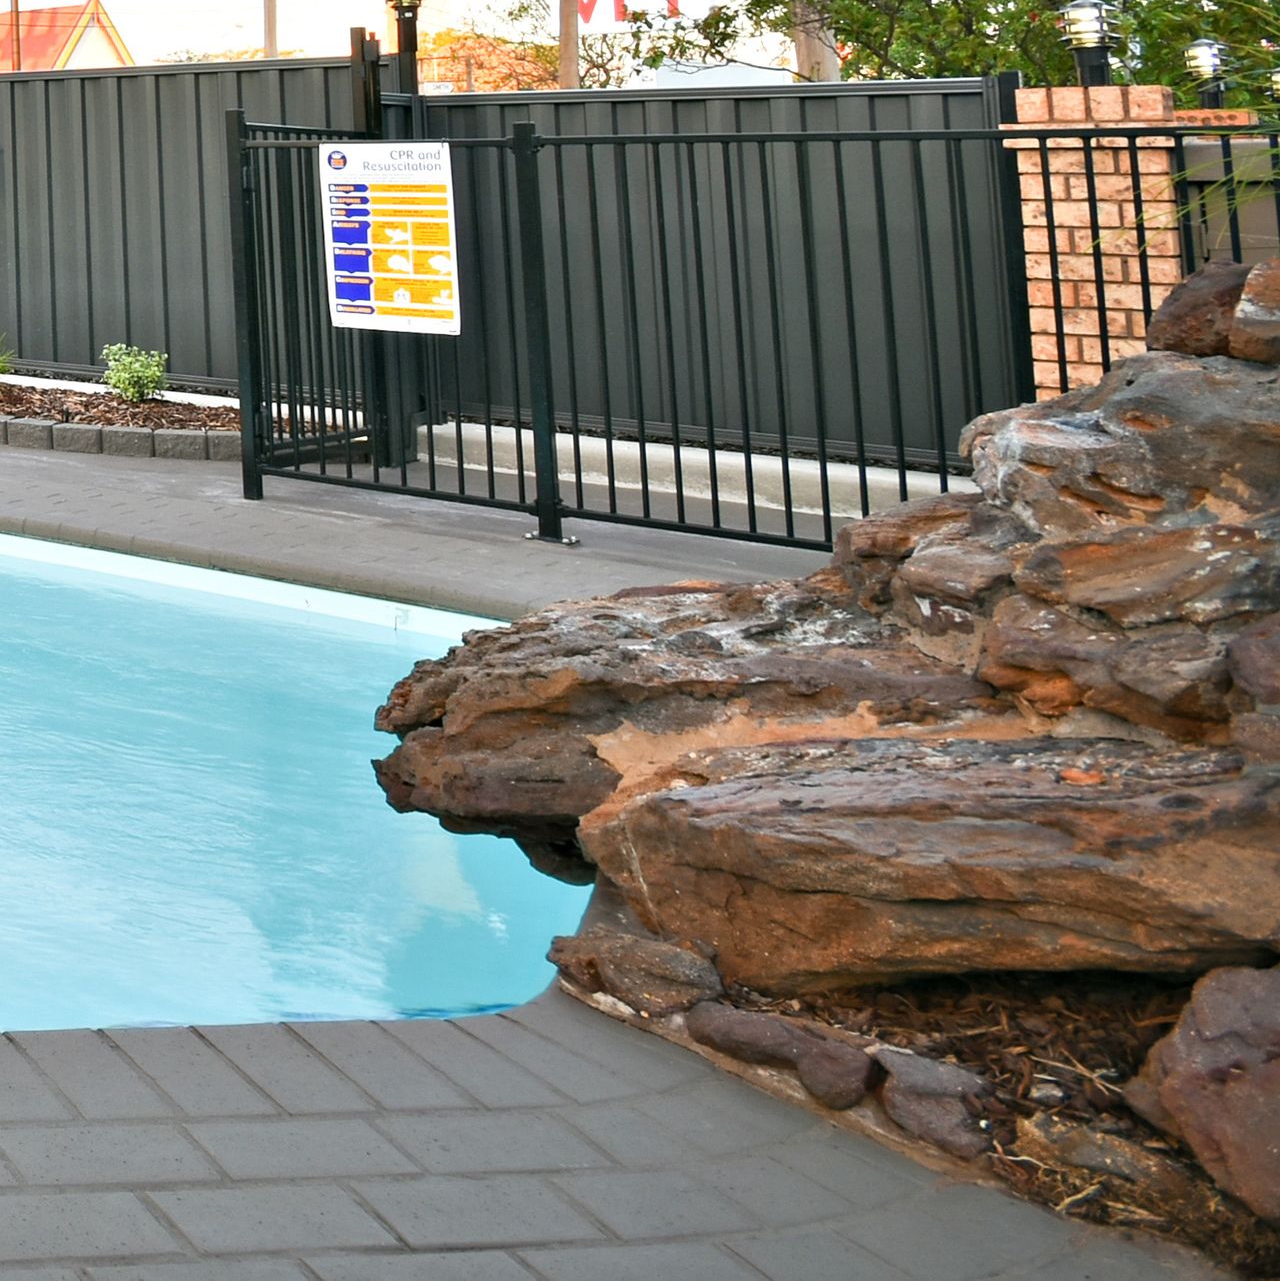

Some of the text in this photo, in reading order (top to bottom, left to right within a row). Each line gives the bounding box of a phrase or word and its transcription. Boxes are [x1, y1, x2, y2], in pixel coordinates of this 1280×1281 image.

[389, 149, 441, 161] CPR and
[362, 161, 442, 172] Resuscitation
